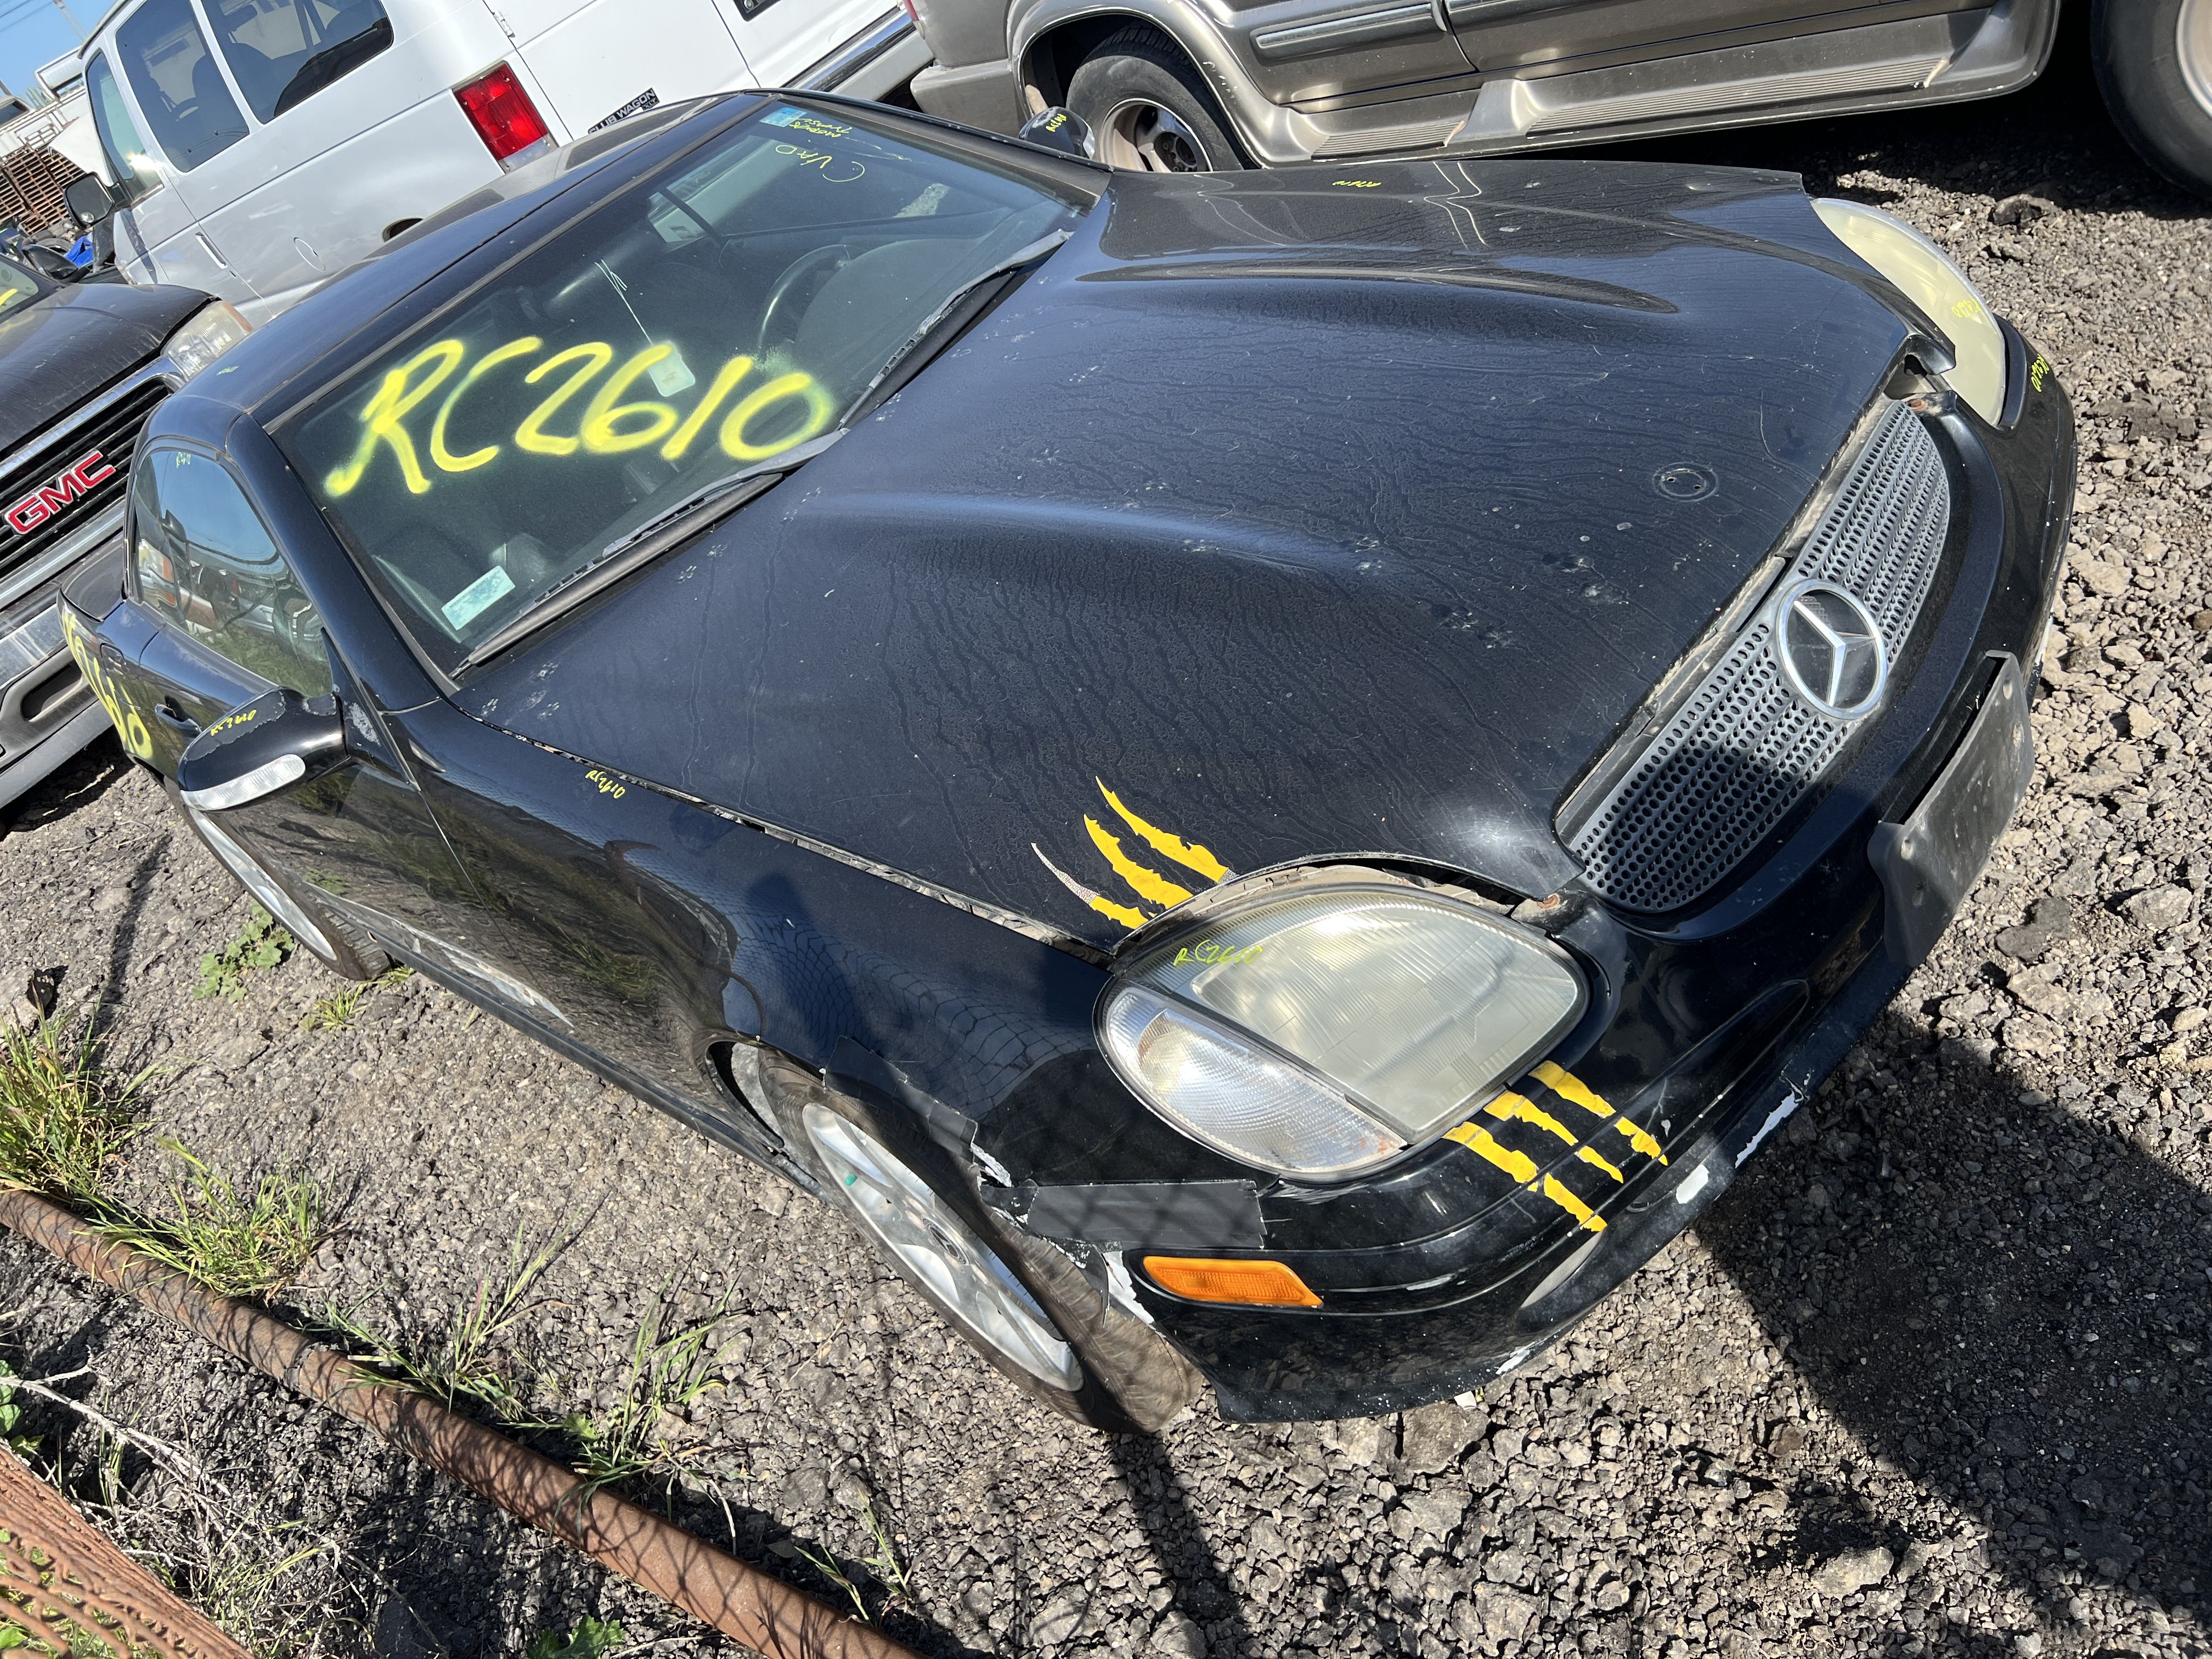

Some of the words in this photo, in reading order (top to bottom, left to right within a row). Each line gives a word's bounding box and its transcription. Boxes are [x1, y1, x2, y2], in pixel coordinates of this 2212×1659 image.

[616, 89, 656, 118] WAGON
[644, 98, 657, 109] XLT
[325, 336, 832, 498] RC2610
[4, 449, 116, 535] GMC
[585, 770, 625, 799] RC2610
[1173, 939, 1263, 966] RC2610
